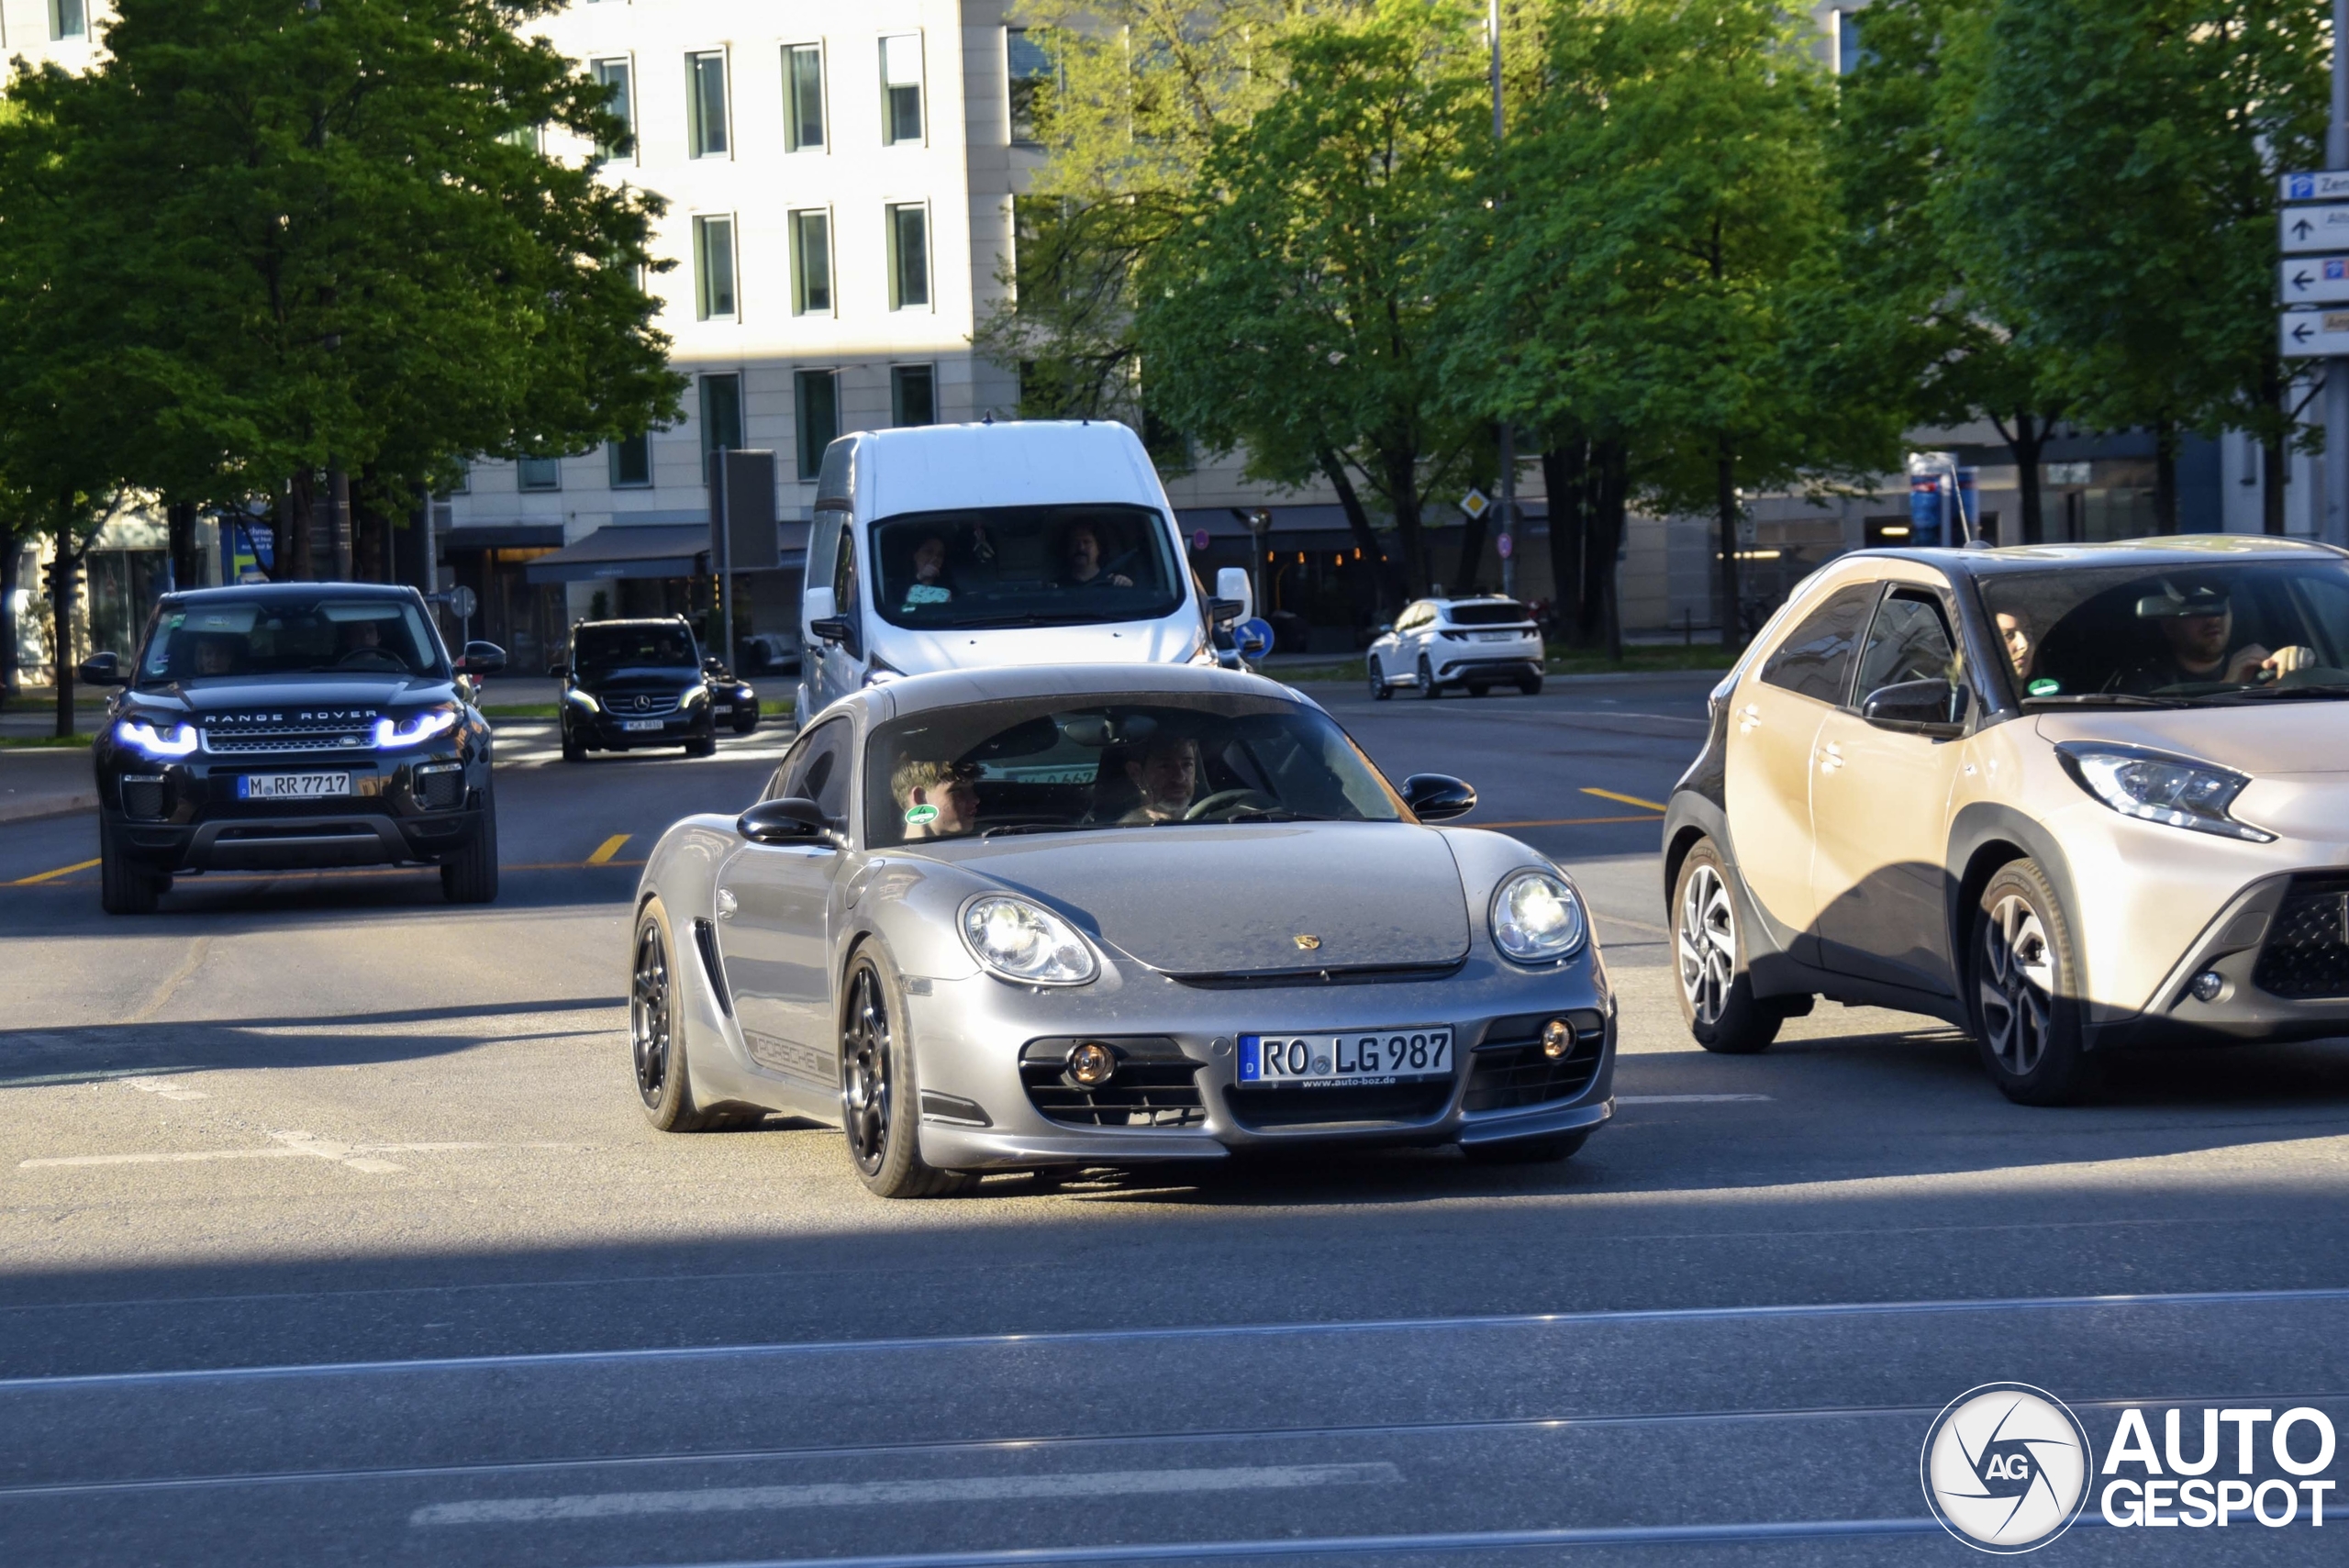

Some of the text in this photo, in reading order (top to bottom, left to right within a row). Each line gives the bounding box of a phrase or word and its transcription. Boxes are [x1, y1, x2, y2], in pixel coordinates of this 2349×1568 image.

[205, 710, 378, 723] RANGE ROVER
[250, 778, 262, 795] M
[275, 777, 298, 795] RR
[302, 775, 347, 794] 7717
[918, 806, 927, 815] 4
[758, 1037, 816, 1071] PORSCHE
[1246, 1033, 1449, 1075] D RO LG 987
[1302, 1075, 1397, 1088] www.auto-boz.de
